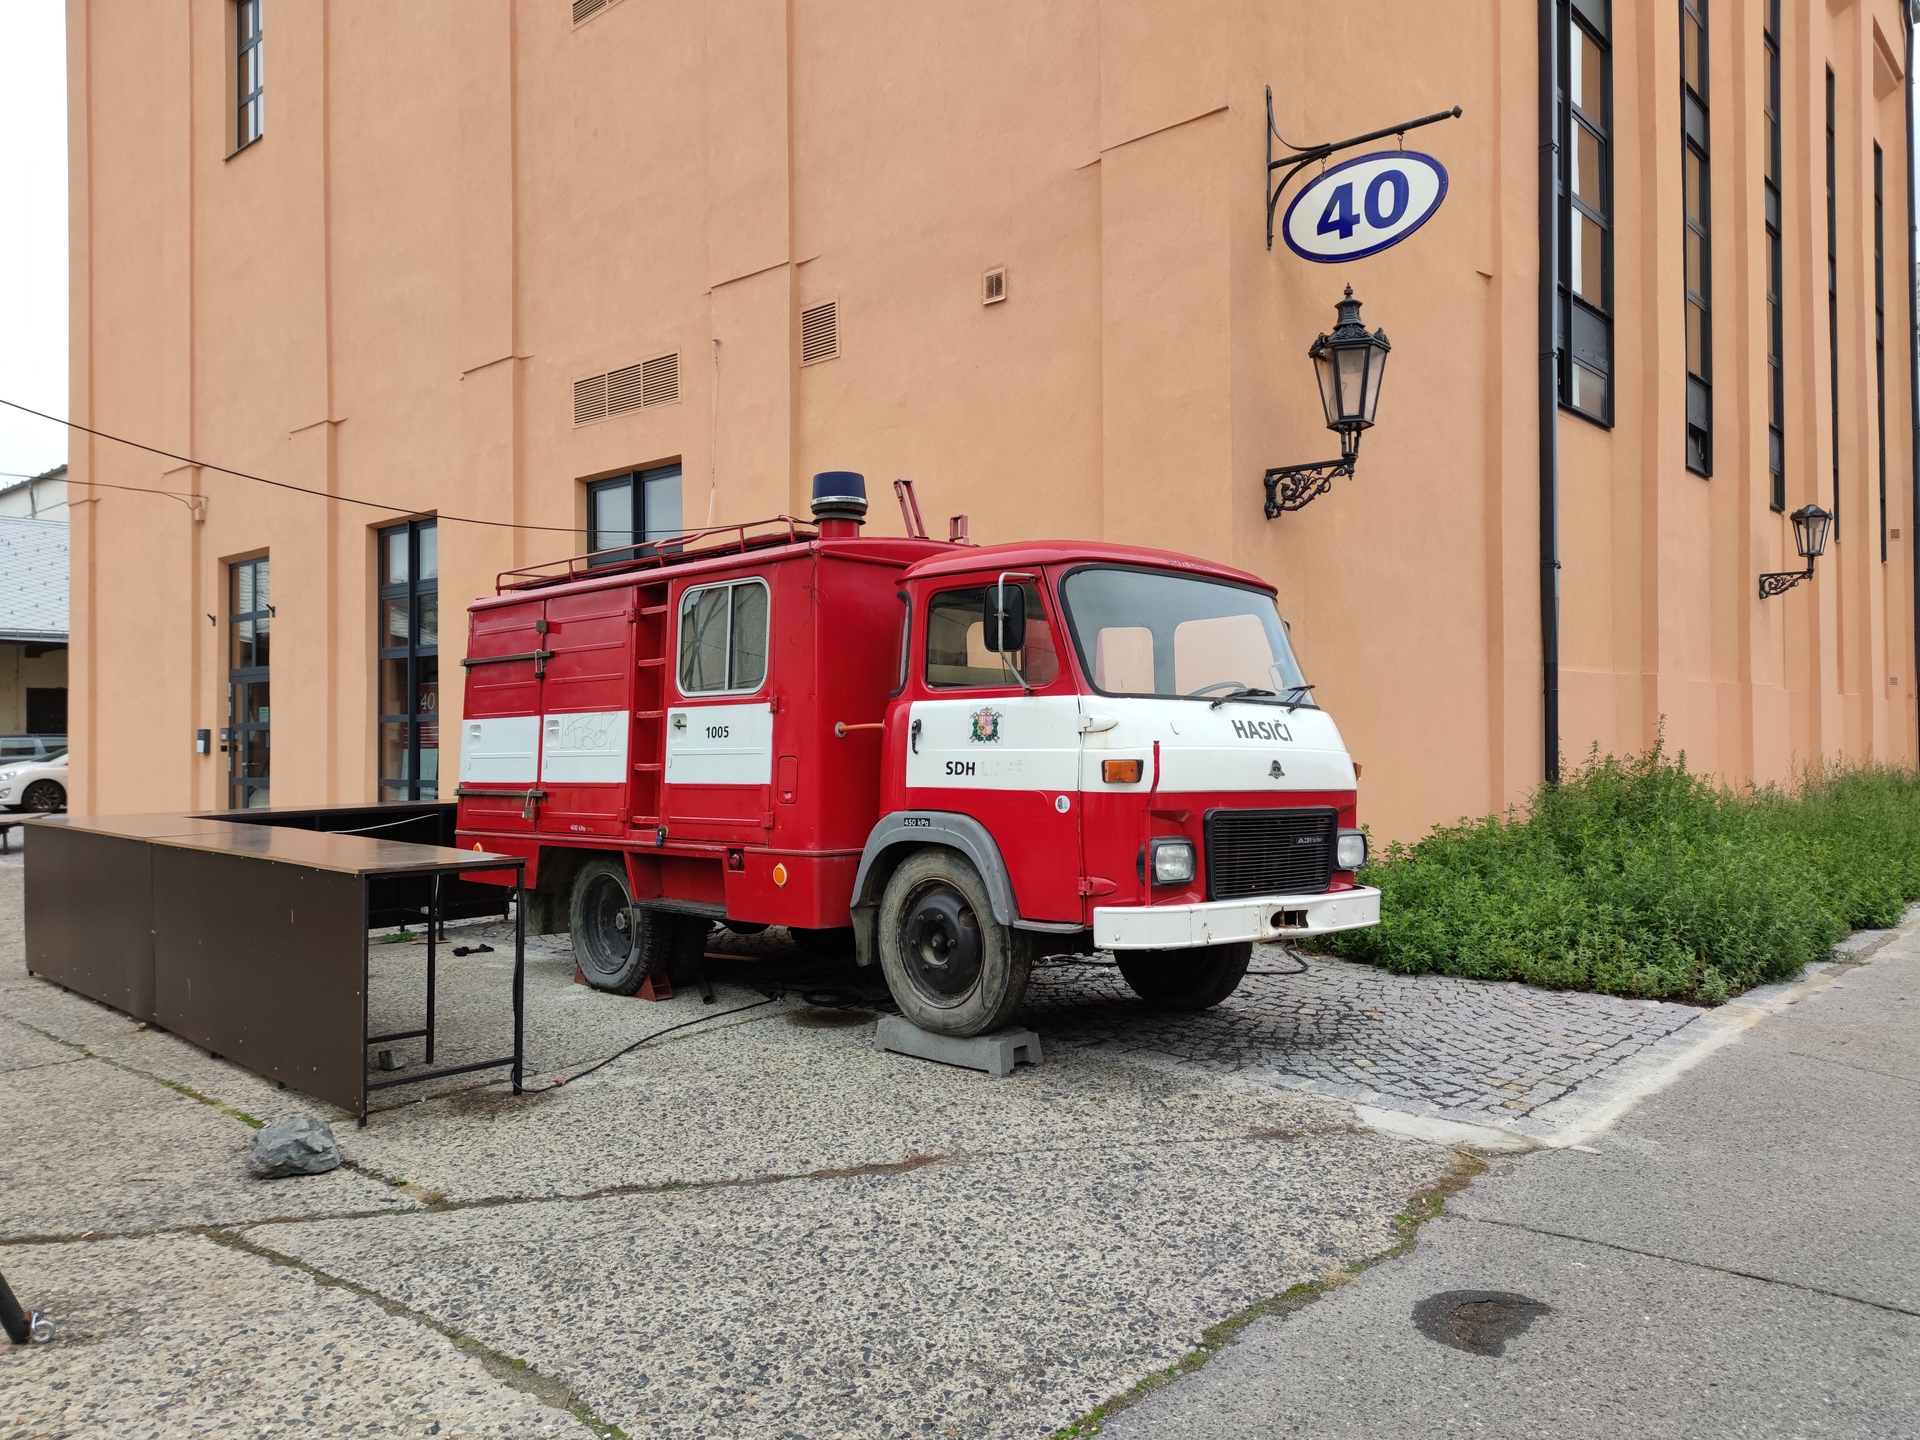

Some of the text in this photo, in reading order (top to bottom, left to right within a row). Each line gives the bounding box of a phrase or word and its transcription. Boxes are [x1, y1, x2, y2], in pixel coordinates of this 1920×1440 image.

[1316, 169, 1410, 240] 40
[420, 692, 436, 710] 40
[706, 726, 729, 739] 1005
[1230, 719, 1294, 742] HASIČI
[945, 761, 976, 776] SDH
[917, 819, 929, 827] kPa
